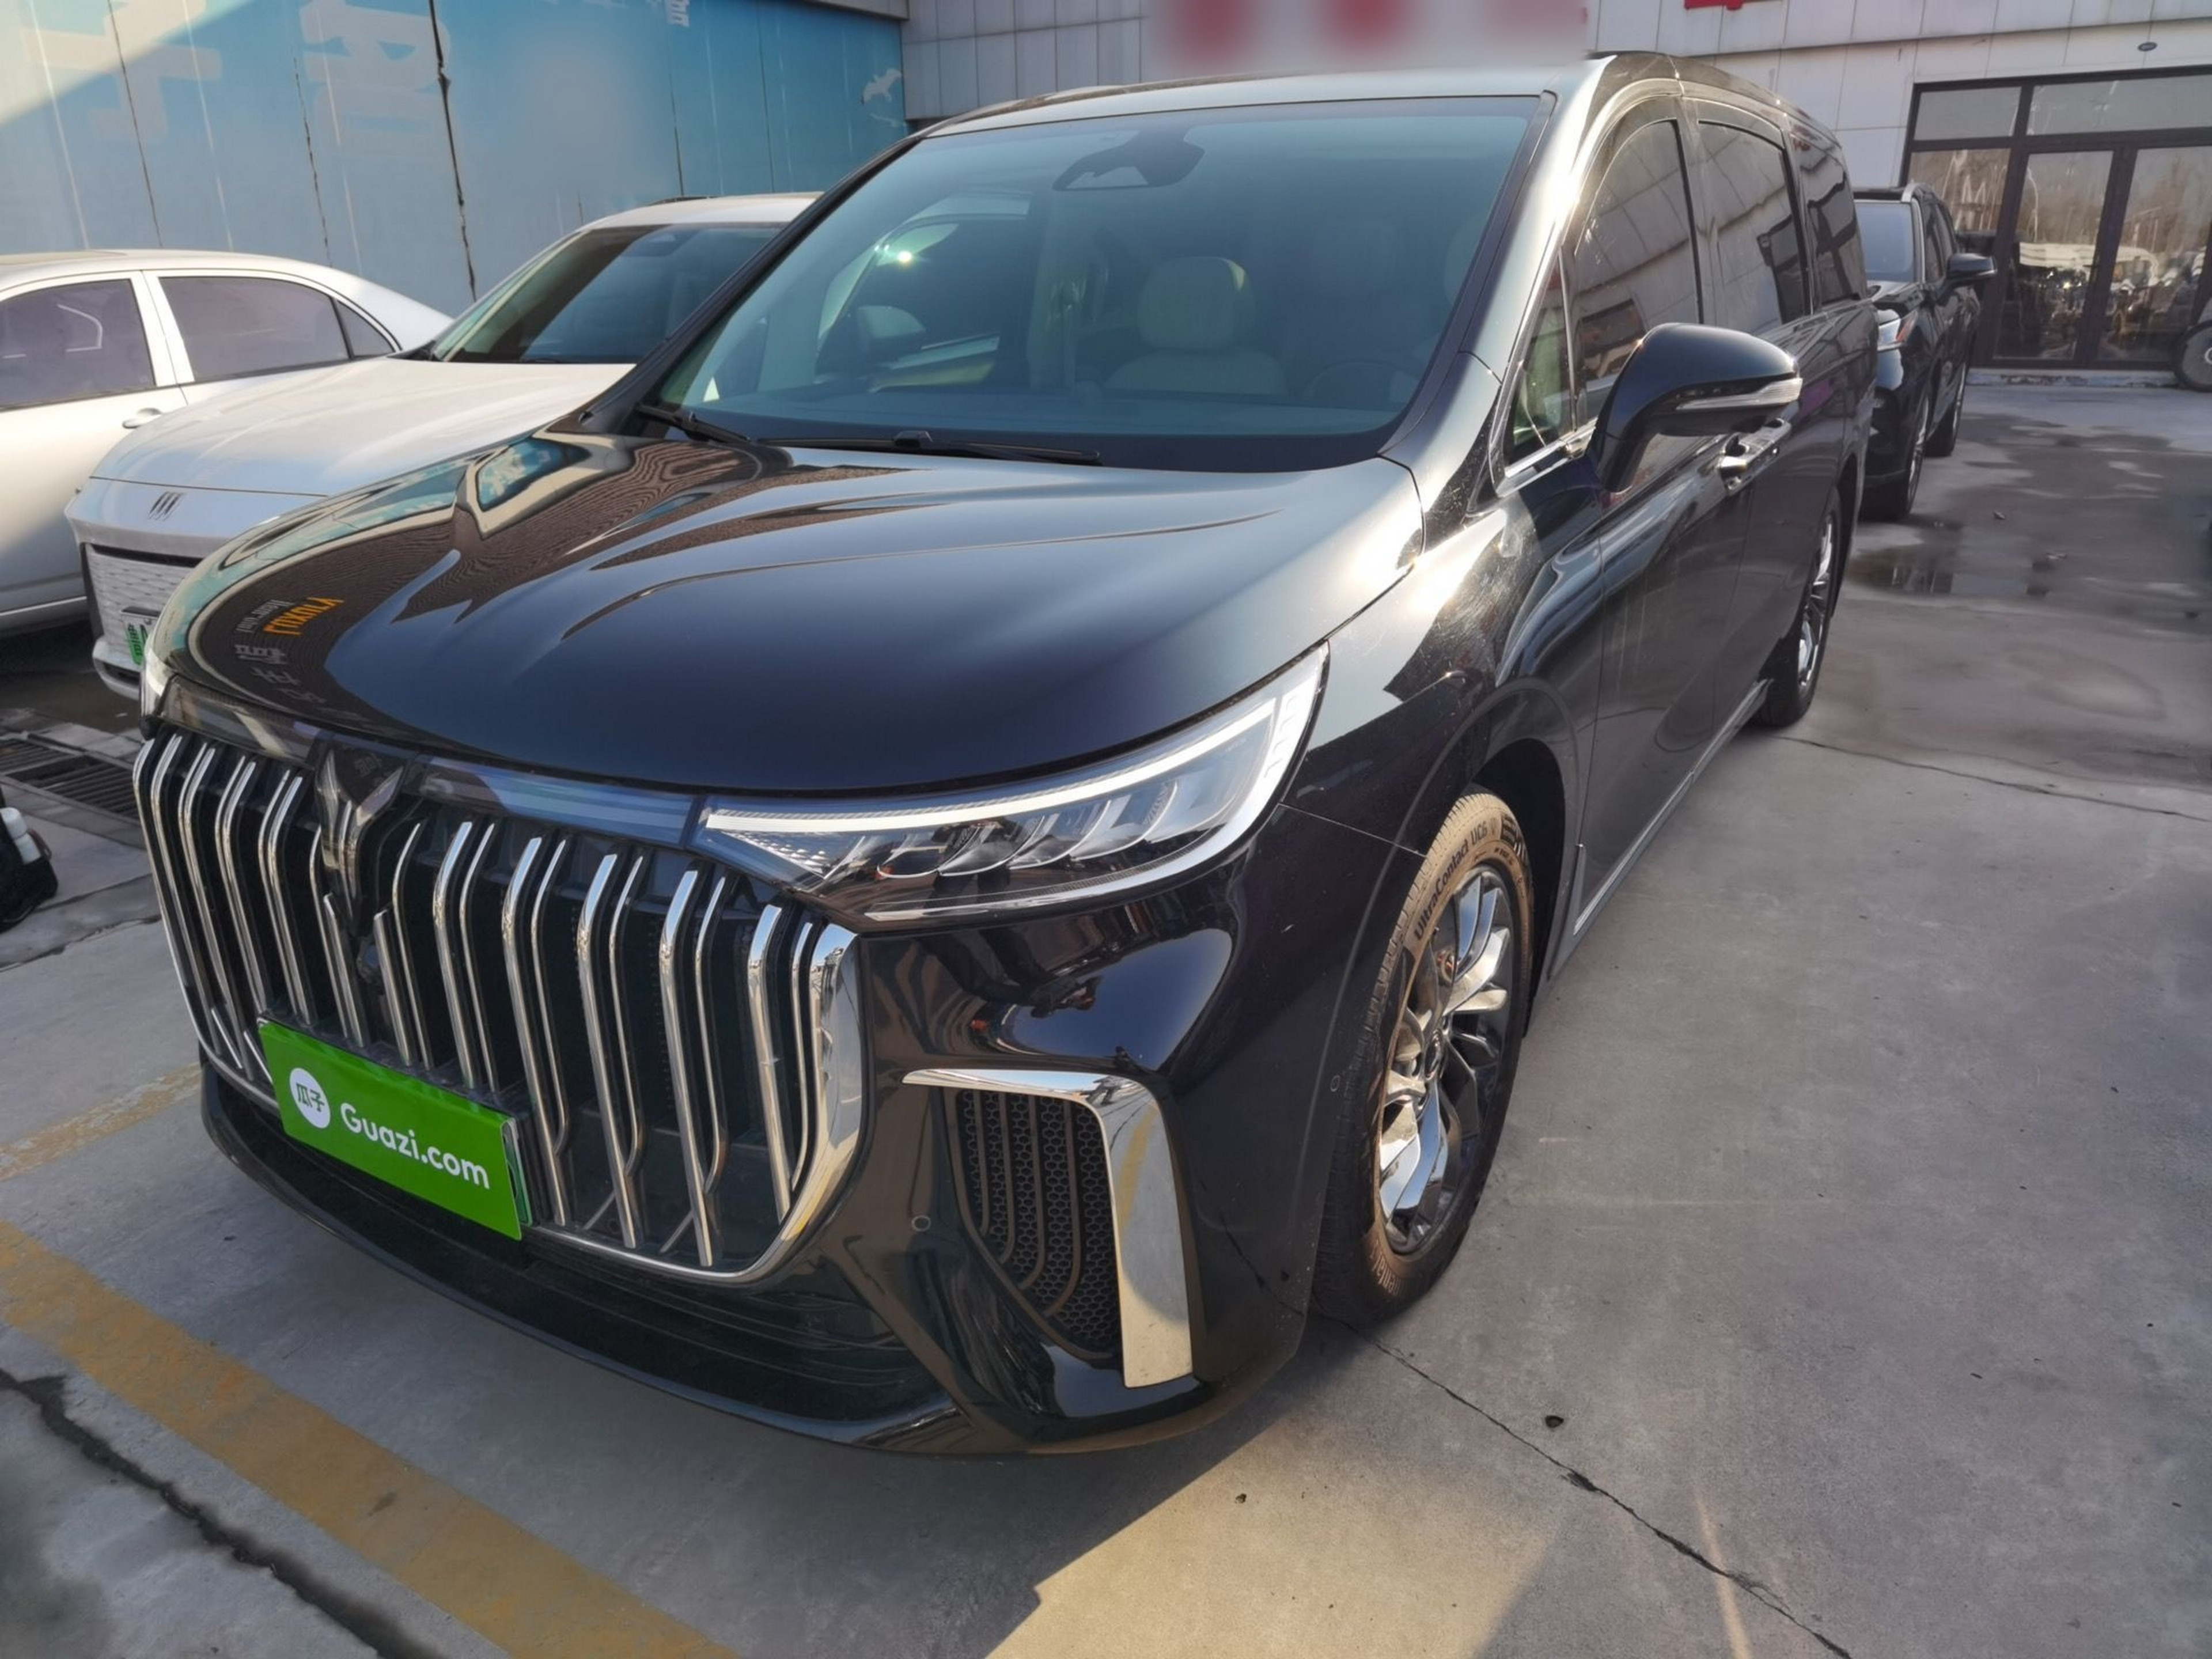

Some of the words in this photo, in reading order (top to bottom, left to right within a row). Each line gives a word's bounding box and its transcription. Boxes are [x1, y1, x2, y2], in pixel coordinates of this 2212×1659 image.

[1413, 839, 1469, 941] UltraContact
[296, 1083, 325, 1112] 瓜子
[340, 1102, 490, 1190] Guazi.com
